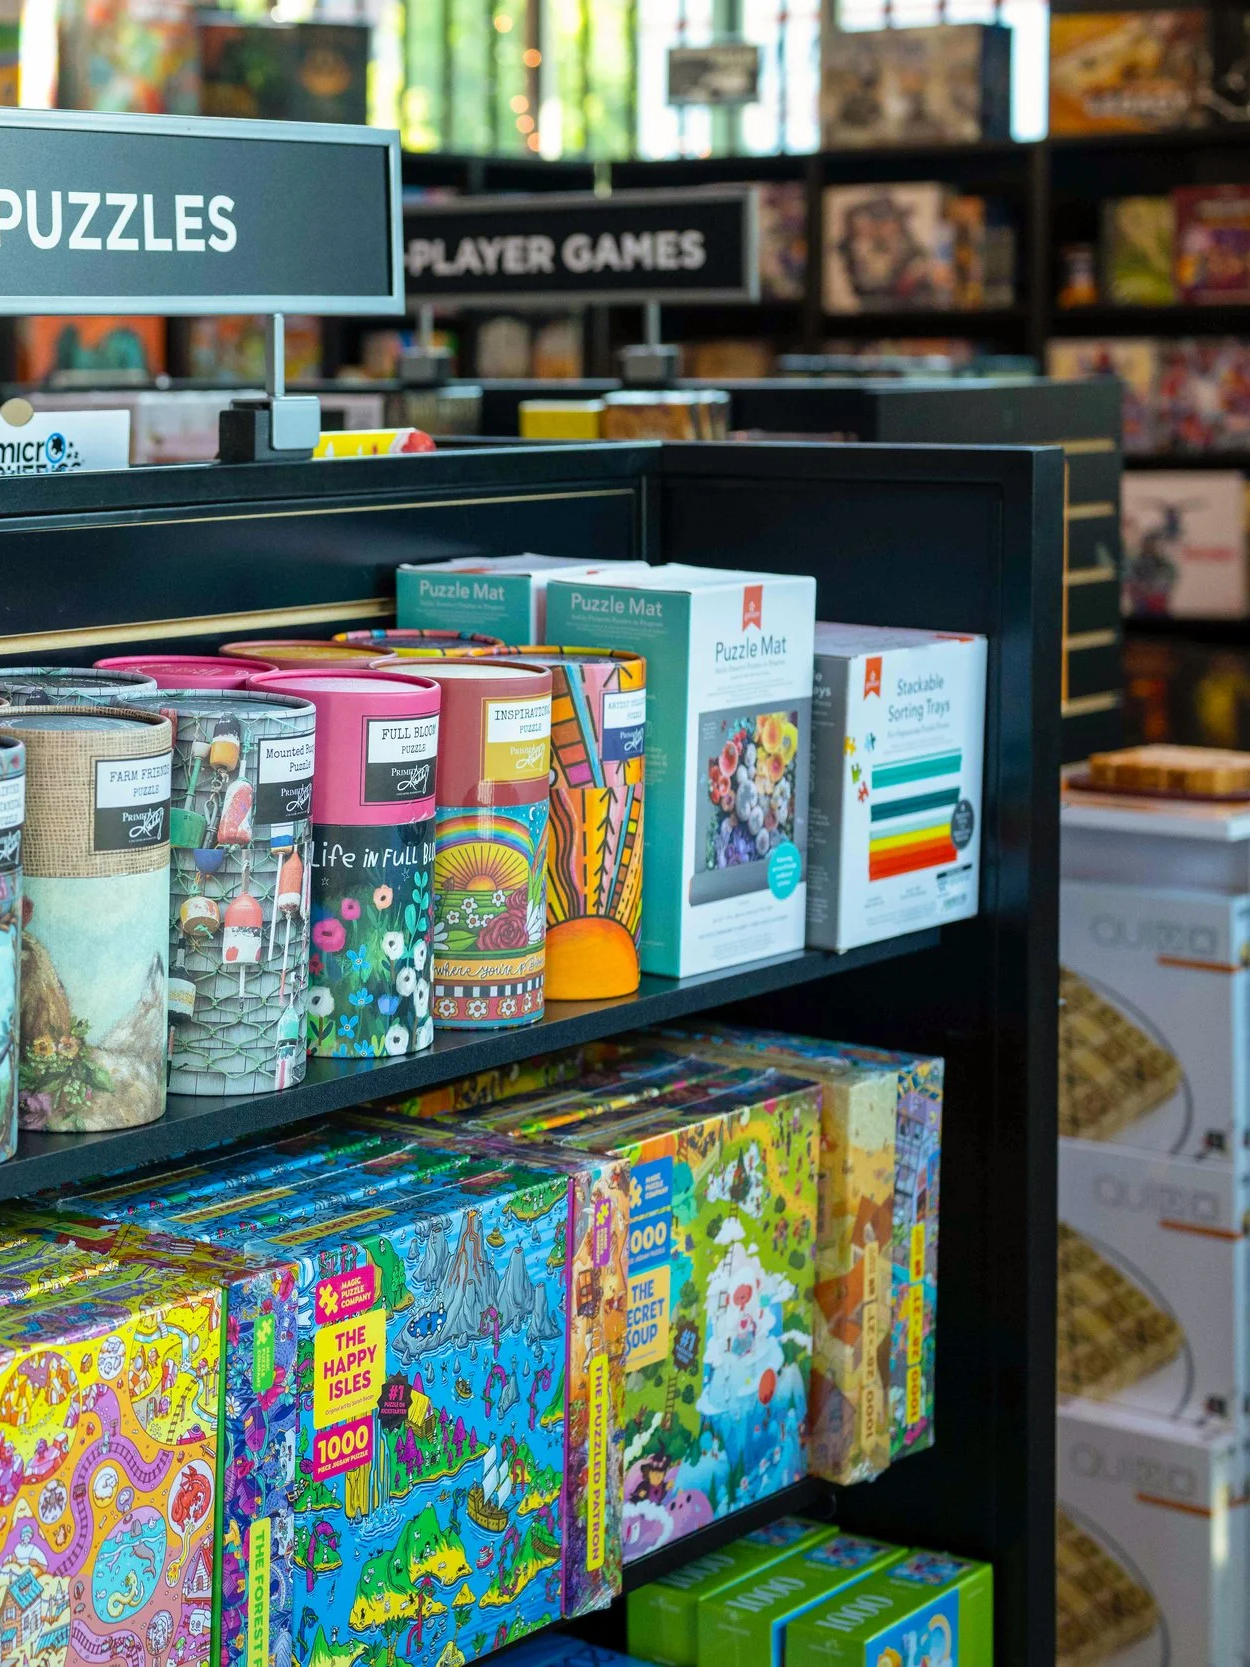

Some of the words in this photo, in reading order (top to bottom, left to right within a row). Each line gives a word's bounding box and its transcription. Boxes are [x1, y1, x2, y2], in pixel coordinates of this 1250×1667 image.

[561, 229, 706, 273] GAMES
[419, 579, 469, 600] Puzzle
[472, 582, 504, 601] Mat
[570, 592, 625, 614] Puzzle
[628, 596, 663, 617] Mat
[715, 638, 758, 663] Puzzle
[761, 634, 787, 655] Mat
[897, 674, 944, 697] Stackable
[888, 703, 924, 723] Sorting
[927, 698, 950, 718] Trays
[381, 728, 411, 740] FULL
[413, 724, 437, 739] BLOOM
[519, 723, 542, 734] PUZZLE
[266, 746, 304, 759] Mounted
[401, 743, 426, 754] PUZZLE
[109, 770, 138, 783] FARM
[141, 764, 170, 780] FRIENDS
[289, 759, 311, 772] Puzzle
[133, 784, 160, 797] PUZZLE
[311, 841, 356, 868] Life
[316, 1216, 360, 1234] HAPPY
[361, 1209, 383, 1221] THE
[277, 1229, 315, 1245] ISLES
[630, 1221, 666, 1254] 000
[341, 1276, 362, 1290] MAGIC
[341, 1284, 365, 1299] PUZZLE
[631, 1279, 654, 1304] THE
[341, 1291, 372, 1308] COMPANY
[626, 1297, 665, 1328] ECRET
[335, 1325, 366, 1352] THE
[625, 1324, 658, 1357] SOUP
[323, 1344, 377, 1380] HAPPY
[329, 1370, 372, 1401] ISLES
[388, 1384, 405, 1401] #1
[594, 1364, 603, 1398] THE
[317, 1425, 369, 1464] 1000
[593, 1403, 603, 1483] PUZZLED
[317, 1463, 331, 1474] PIECE
[331, 1456, 350, 1471] JIGSAW
[350, 1449, 368, 1464] PUZZLE
[592, 1487, 601, 1560] PATRON
[254, 1529, 265, 1571] THE
[656, 1553, 735, 1590] 1000
[725, 1575, 806, 1613] 1000
[253, 1574, 264, 1651] FOREST
[814, 1594, 894, 1632] 1000
